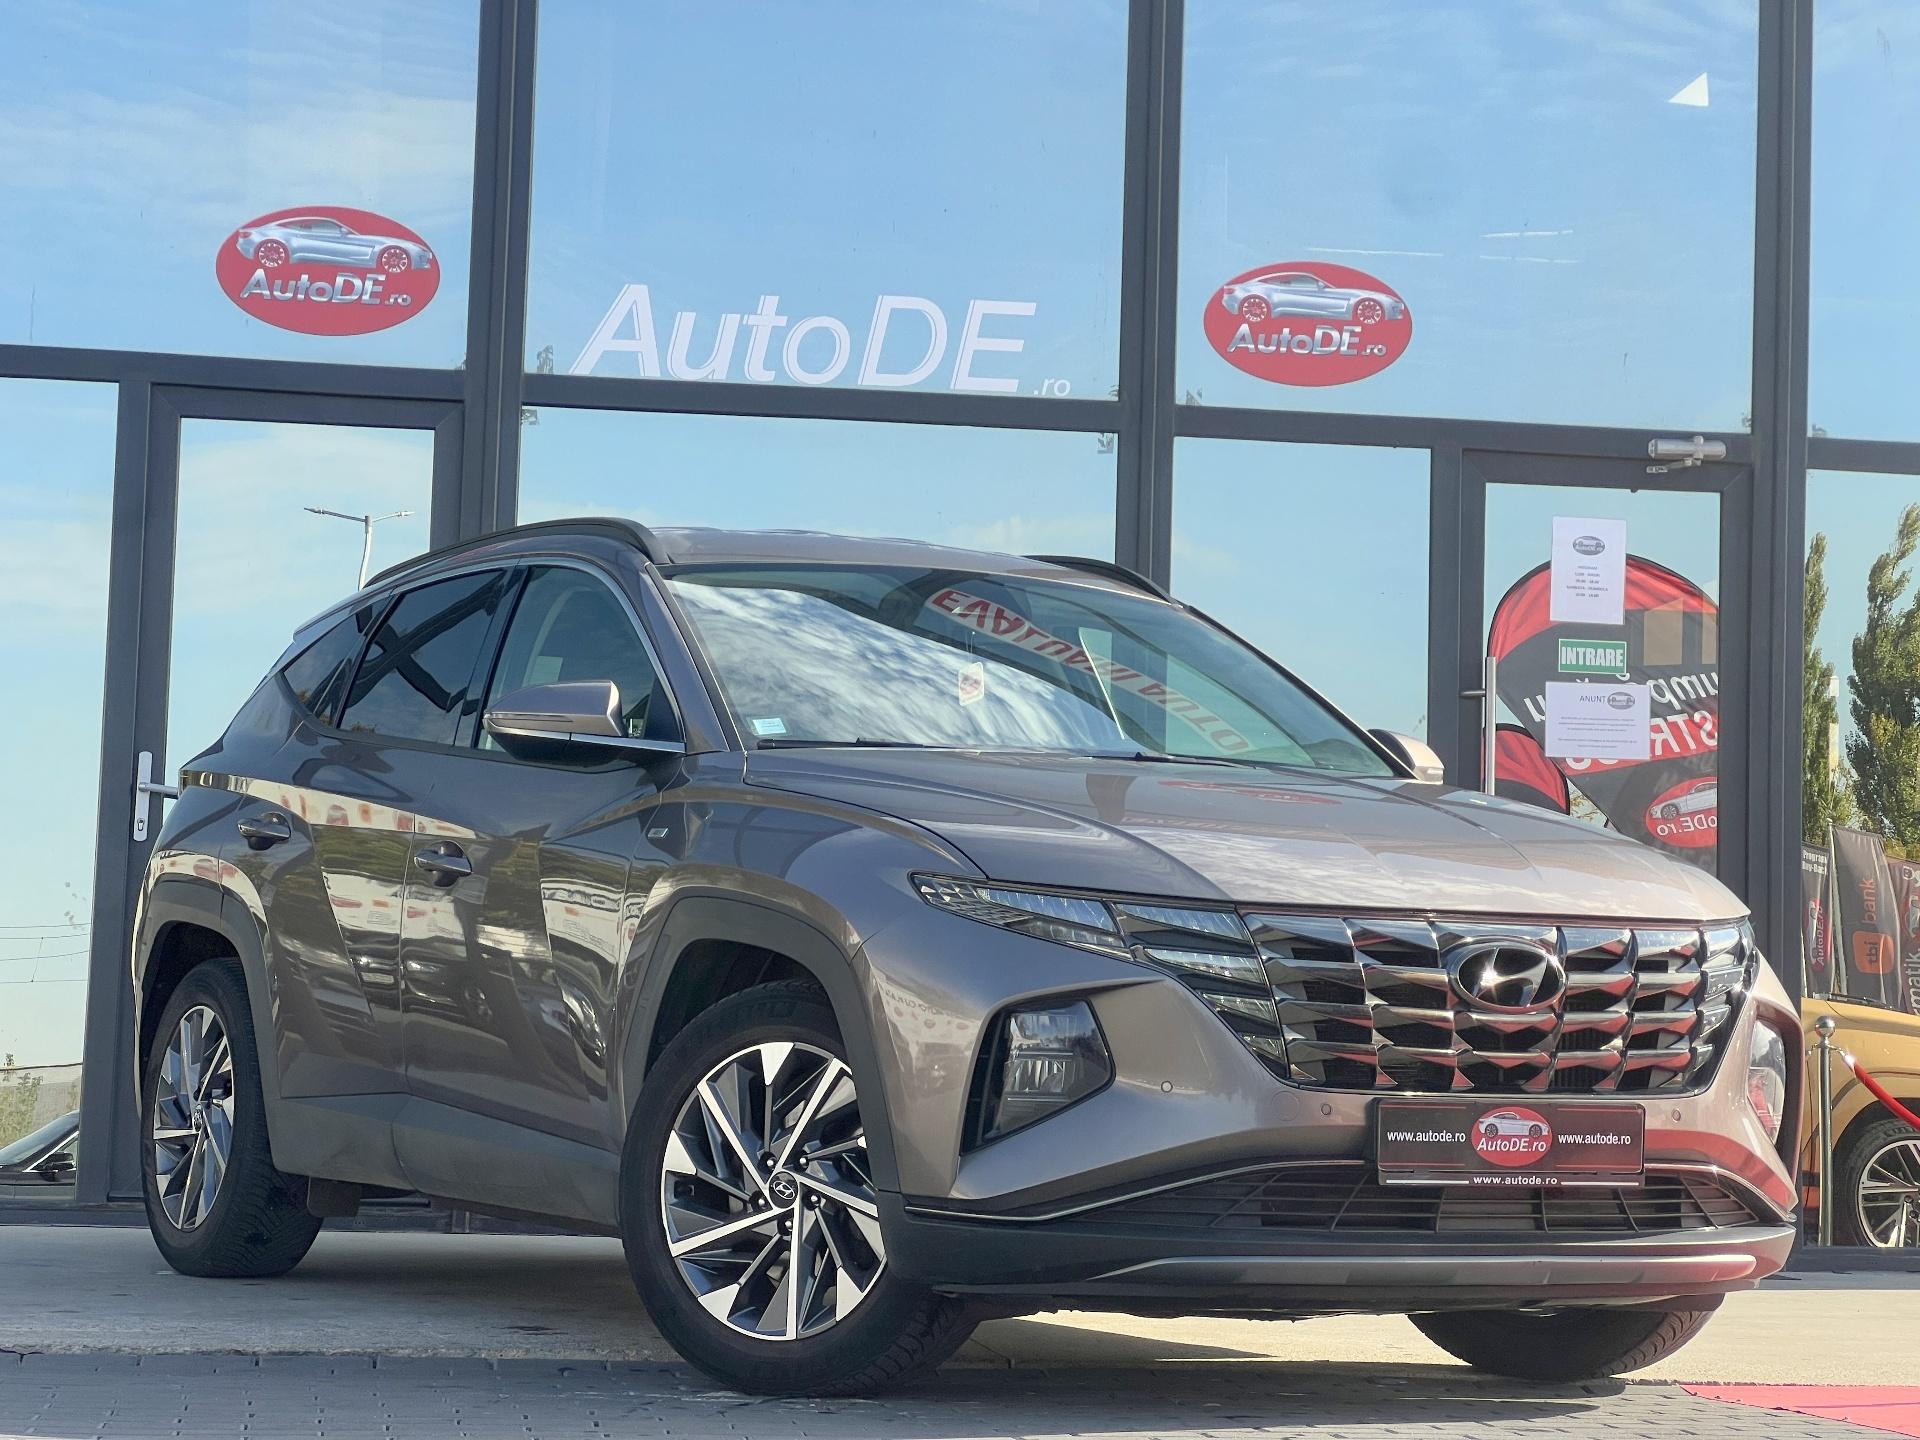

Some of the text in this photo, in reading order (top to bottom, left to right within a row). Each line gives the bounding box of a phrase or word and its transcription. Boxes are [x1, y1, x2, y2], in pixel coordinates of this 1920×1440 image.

[1561, 646, 1624, 668] INTRARE
[1859, 877, 1877, 925] bank
[1387, 1129, 1466, 1143] www.autode.ro
[1558, 1133, 1631, 1145] www.autode.ro
[1476, 1137, 1547, 1152] AutoDE.ro
[1473, 1175, 1558, 1185] www.autode.ro
